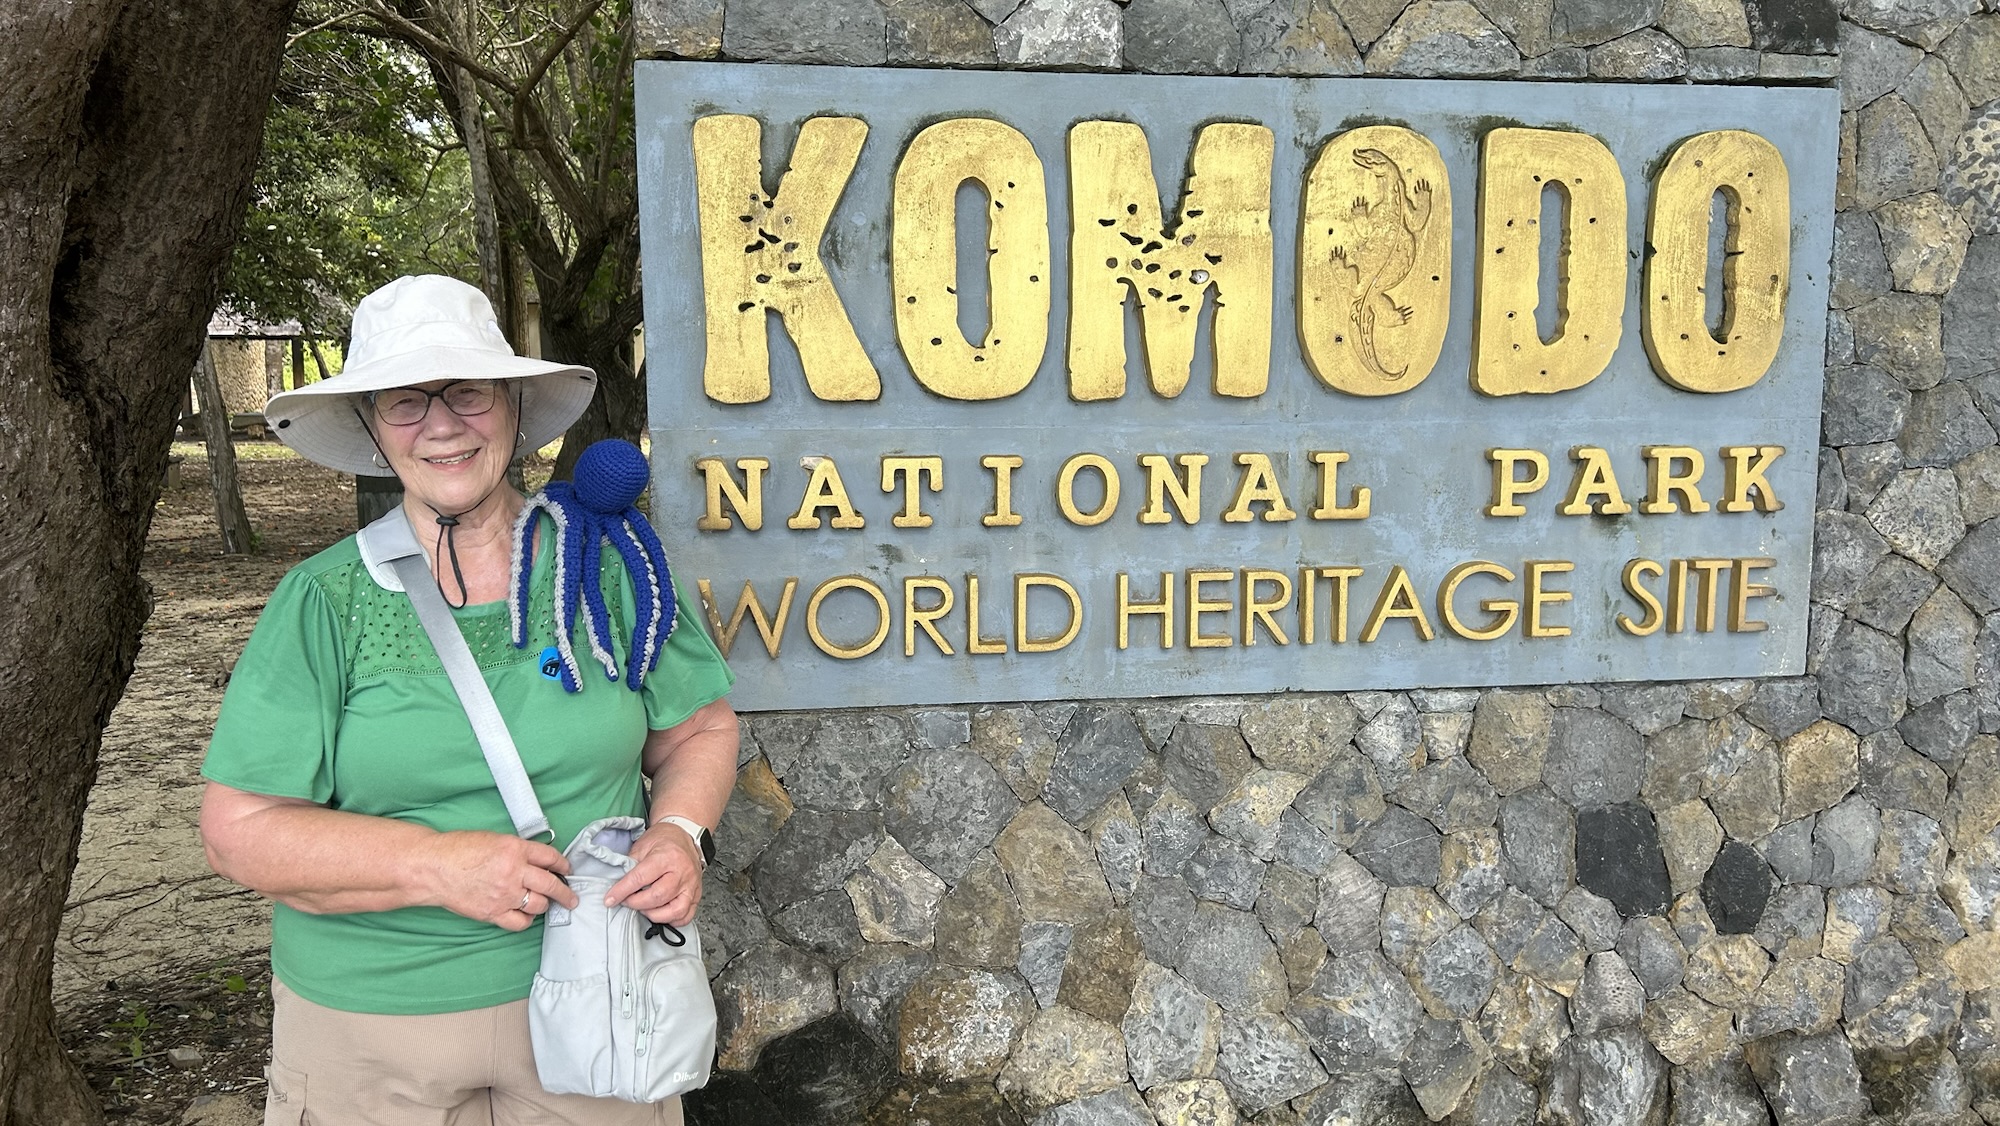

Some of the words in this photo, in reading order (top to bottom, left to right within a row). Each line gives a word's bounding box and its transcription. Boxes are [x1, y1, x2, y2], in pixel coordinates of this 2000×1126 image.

[692, 114, 1791, 404] KOMODO
[697, 453, 1371, 531] NATIONAL
[1484, 445, 1786, 518] PARK
[698, 571, 1084, 660] WORLD
[1116, 560, 1574, 648] HERITAGE
[1617, 557, 1778, 637] SITE
[546, 665, 556, 675] 11
